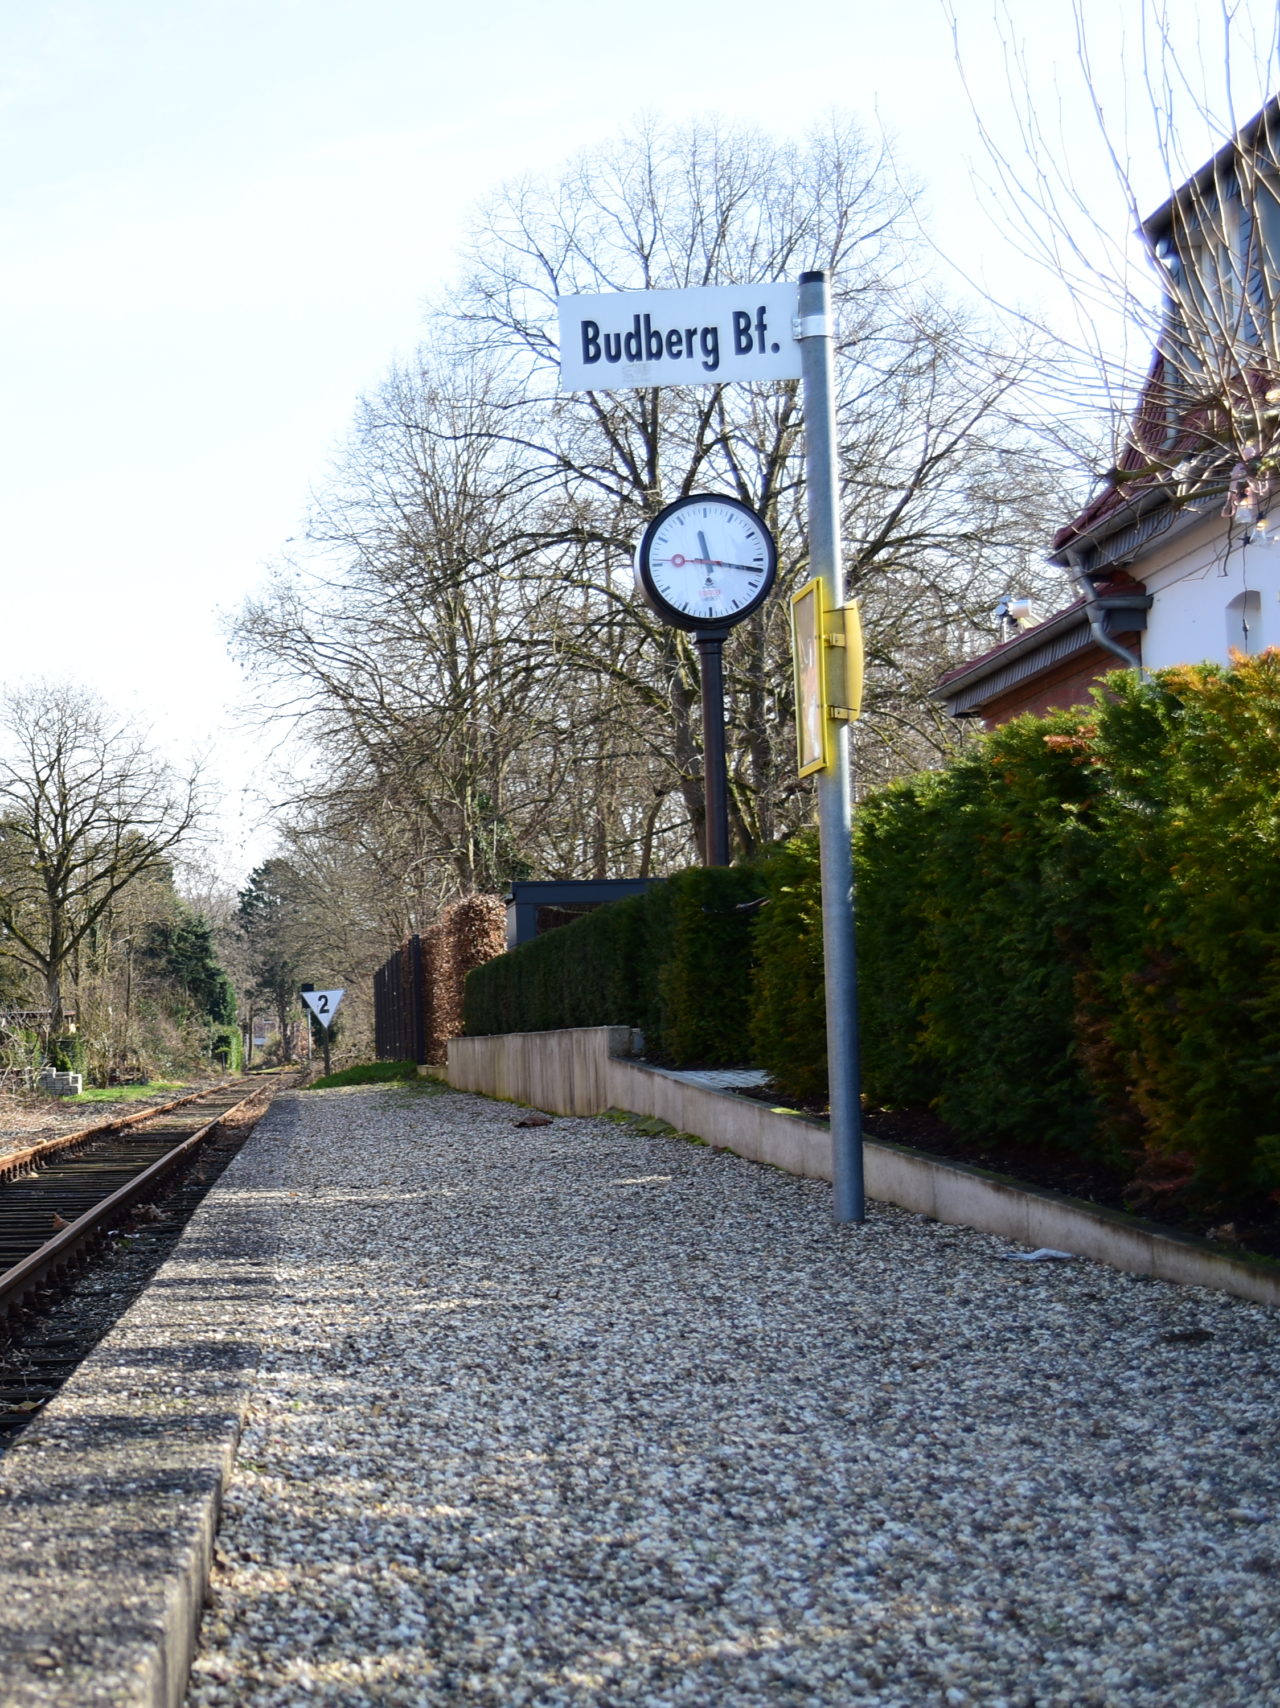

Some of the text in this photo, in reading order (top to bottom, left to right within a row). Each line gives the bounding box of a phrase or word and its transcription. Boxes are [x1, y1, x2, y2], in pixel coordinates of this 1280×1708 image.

[581, 305, 780, 371] Budberg Bf.
[318, 995, 330, 1014] 2
